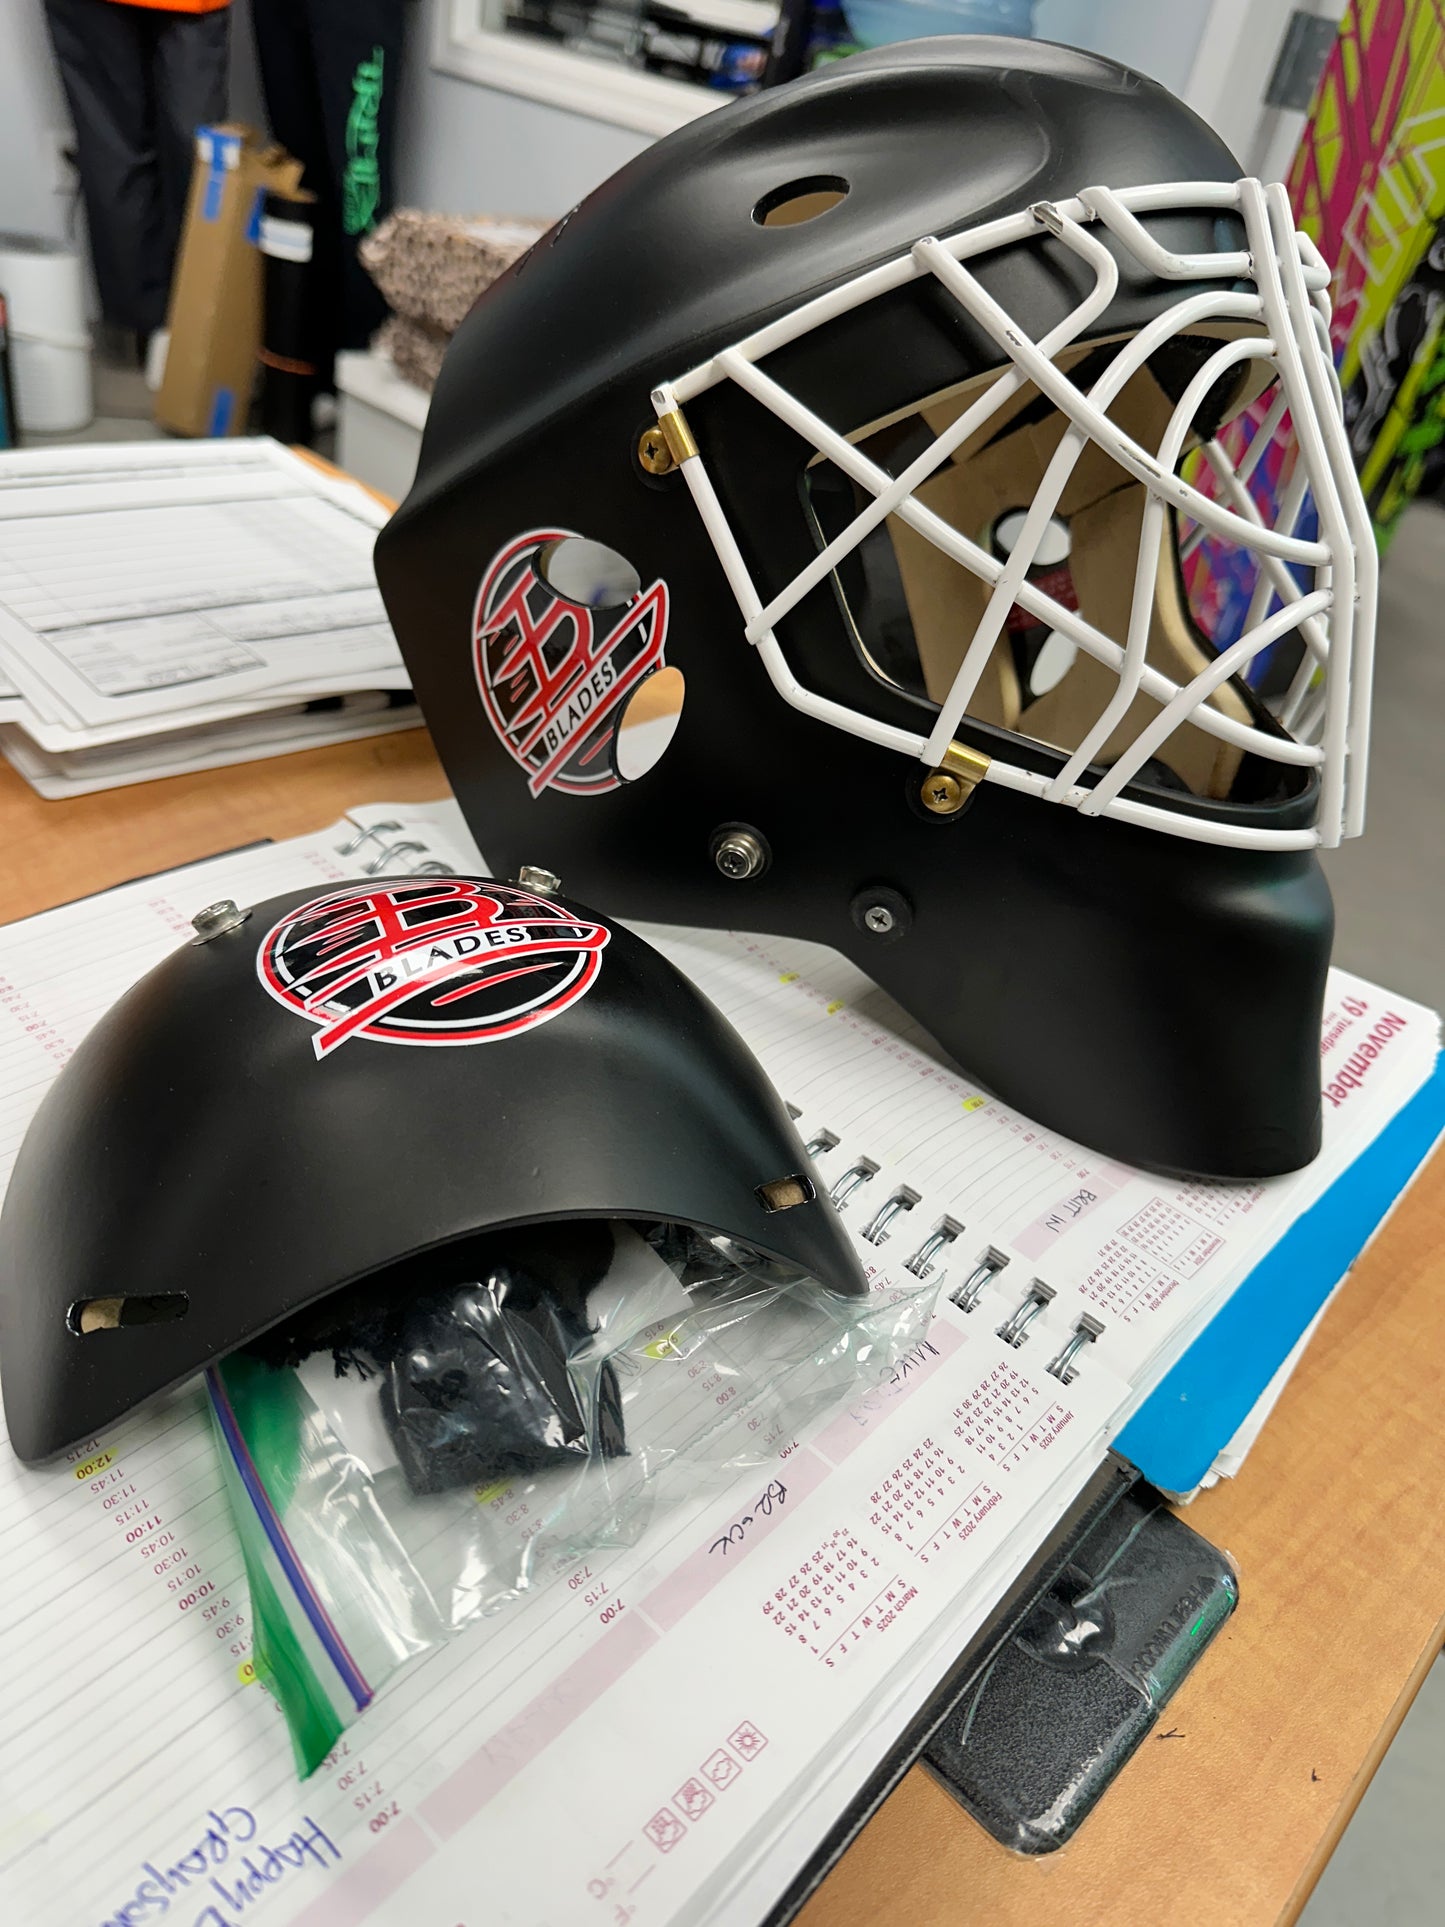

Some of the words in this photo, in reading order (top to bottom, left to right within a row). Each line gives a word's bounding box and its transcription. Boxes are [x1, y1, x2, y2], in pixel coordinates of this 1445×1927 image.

[546, 661, 616, 752] BLADES
[374, 926, 528, 992] BLADES
[1340, 996, 1369, 1018] 19
[1321, 1011, 1407, 1108] November
[874, 1277, 891, 1293] 7:45
[1019, 1378, 1029, 1389] 12
[1010, 1387, 1020, 1398] 13
[1001, 1397, 1012, 1408] 14
[992, 1406, 1003, 1417] 15
[1056, 1405, 1064, 1413] S
[983, 1416, 994, 1426] 16
[1046, 1414, 1056, 1424] M
[1051, 1410, 1074, 1436] January
[975, 1425, 985, 1436] 17
[1039, 1425, 1047, 1433] T
[964, 1435, 975, 1446] 18
[1006, 1433, 1015, 1441] 2
[1029, 1433, 1039, 1443] W
[1039, 1432, 1055, 1450] 2025
[922, 1437, 934, 1450] 23
[998, 1442, 1006, 1451] 3
[1021, 1444, 1029, 1452] T
[64, 1438, 100, 1463] 12:15
[912, 1448, 924, 1460] 24
[933, 1447, 944, 1458] 16
[947, 1457, 954, 1465] 9
[988, 1453, 995, 1461] 4
[1013, 1453, 1020, 1462] F
[77, 1454, 112, 1479] 12:00
[902, 1458, 914, 1471] 25
[924, 1458, 934, 1469] 17
[957, 1465, 965, 1474] 2
[1002, 1463, 1011, 1472] S
[891, 1469, 903, 1481] 26
[913, 1468, 924, 1480] 18
[934, 1466, 945, 1478] 10
[90, 1468, 124, 1494] 11:45
[882, 1480, 893, 1493] 27
[903, 1479, 914, 1490] 19
[924, 1477, 935, 1489] 11
[947, 1476, 955, 1485] 3
[892, 1489, 904, 1502] 20
[913, 1488, 925, 1500] 12
[937, 1488, 944, 1496] 4
[982, 1485, 991, 1494] S
[102, 1484, 137, 1510] 11:30
[870, 1491, 882, 1504] 28
[927, 1498, 935, 1507] 5
[971, 1495, 982, 1506] M
[881, 1500, 893, 1513] 21
[903, 1499, 914, 1511] 13
[973, 1491, 1003, 1523] February
[115, 1499, 150, 1526] 11:15
[869, 1512, 882, 1525] 22
[892, 1511, 904, 1522] 14
[916, 1509, 924, 1518] 6
[963, 1508, 972, 1517] T
[125, 1515, 163, 1544] 11:00
[881, 1522, 892, 1535] 15
[907, 1521, 914, 1530] 7
[952, 1518, 962, 1530] W
[943, 1531, 951, 1540] T
[958, 1520, 977, 1541] 2025
[846, 1537, 858, 1549] 16
[894, 1533, 903, 1542] 8
[140, 1531, 175, 1559] 10:45
[933, 1541, 940, 1551] F
[811, 1550, 824, 1564] 25
[836, 1549, 847, 1562] 17
[860, 1548, 868, 1557] 9
[920, 1554, 929, 1563] S
[153, 1547, 188, 1575] 10:30
[846, 1559, 858, 1571] 10
[870, 1557, 880, 1567] 2
[799, 1562, 812, 1576] 26
[822, 1561, 835, 1574] 18
[167, 1564, 202, 1592] 10:15
[568, 1566, 592, 1590] 7:30
[812, 1573, 823, 1586] 19
[834, 1571, 846, 1583] 11
[859, 1569, 868, 1579] 3
[788, 1575, 800, 1589] 27
[848, 1582, 855, 1591] 4
[178, 1580, 216, 1611] 10:00
[584, 1581, 610, 1607] 7:15
[774, 1587, 788, 1602] 28
[799, 1585, 811, 1599] 20
[822, 1583, 835, 1596] 12
[786, 1597, 799, 1611] 21
[810, 1596, 822, 1609] 13
[836, 1594, 845, 1604] 5
[893, 1586, 919, 1612] March
[201, 1596, 231, 1622] 9:45
[599, 1598, 626, 1625] 7:00
[762, 1601, 775, 1615] 29
[824, 1607, 832, 1616] 6
[772, 1611, 786, 1625] 22
[797, 1609, 810, 1622] 14
[876, 1609, 897, 1632] 2025
[216, 1613, 245, 1639] 9:30
[784, 1623, 797, 1636] 15
[813, 1620, 821, 1631] 7
[798, 1634, 807, 1644] 8
[810, 1646, 819, 1654] 1
[337, 1761, 367, 1791] 7:30
[354, 1781, 384, 1811] 7:15
[369, 1801, 403, 1833] 7:00
